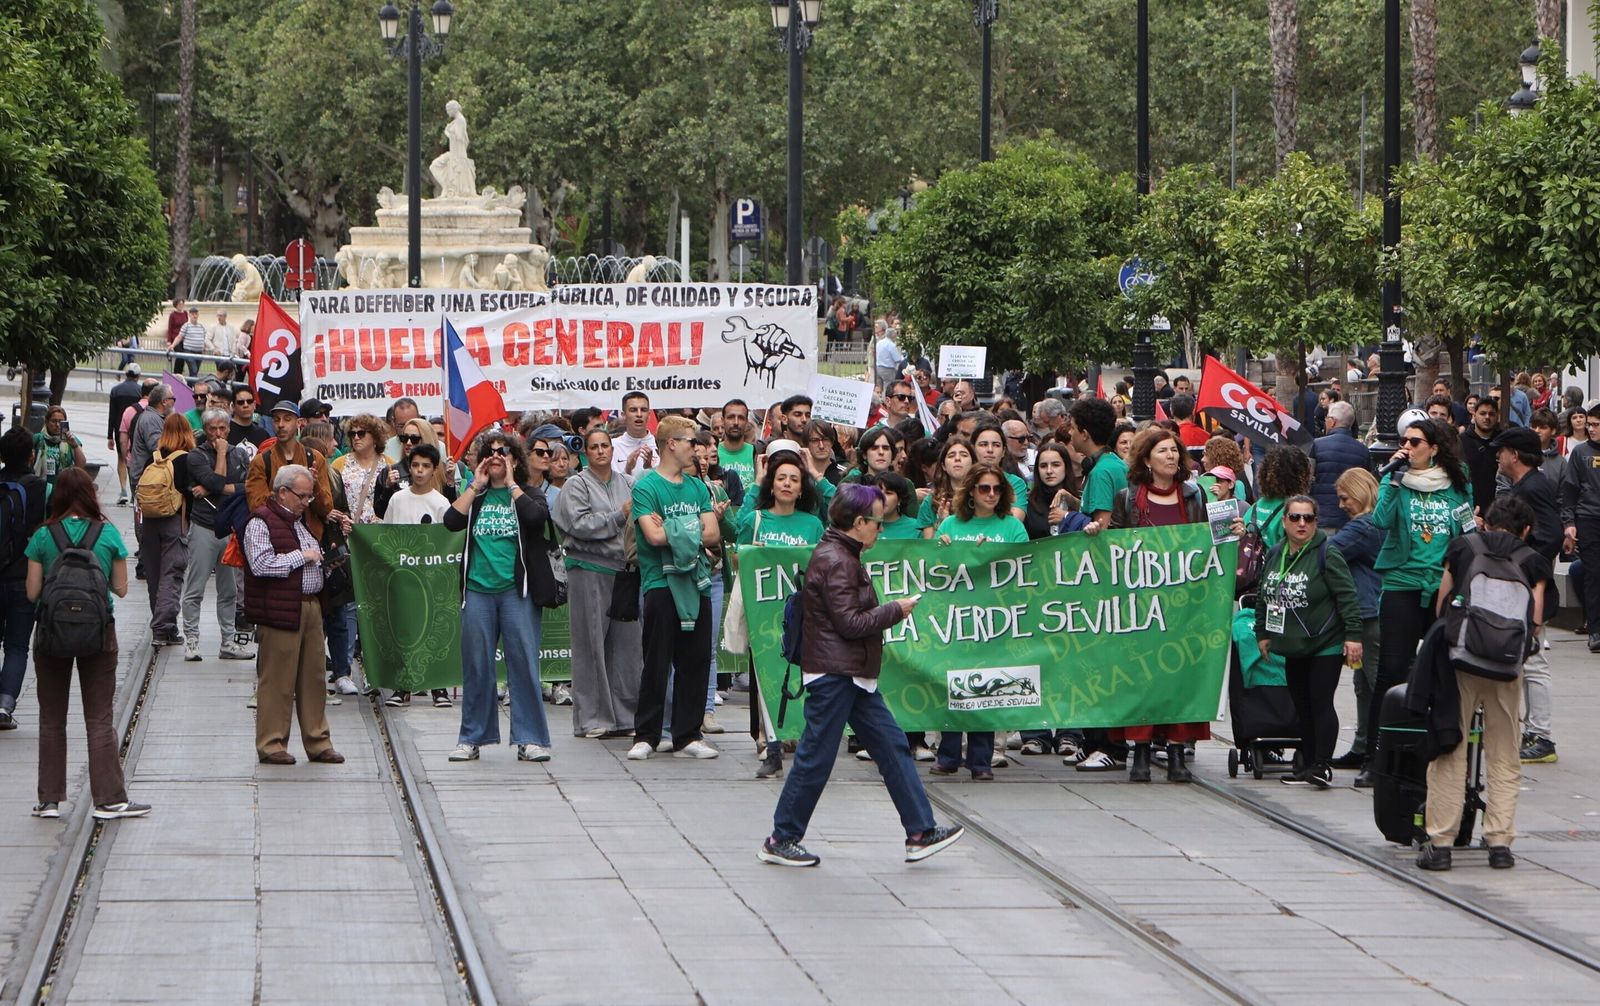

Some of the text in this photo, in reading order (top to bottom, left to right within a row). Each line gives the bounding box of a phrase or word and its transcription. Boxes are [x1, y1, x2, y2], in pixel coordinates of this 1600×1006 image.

[737, 198, 754, 225] P
[308, 295, 350, 314] PARA
[355, 294, 435, 313] DEFENDER
[441, 293, 475, 312] UNA
[480, 293, 546, 313] ESCUELA
[626, 286, 648, 307] DE
[651, 286, 721, 307] CALIDAD
[727, 287, 738, 307] Y
[743, 287, 812, 308] SEGURA
[502, 318, 704, 368] GENERAL!
[316, 383, 385, 400] IZQUIERDA
[530, 375, 721, 392] Sindicato de Estudiantes
[1220, 383, 1301, 440] CGT
[1230, 409, 1279, 443] SEVILLA
[1208, 504, 1234, 514] HUELGA
[399, 553, 420, 567] Por
[425, 554, 442, 566] un
[755, 539, 1225, 602] EN FENSA DE LA PÚBLICA
[928, 603, 1033, 644] VERDE
[1038, 593, 1168, 635] SEVILLA
[949, 697, 1040, 710] MAREA VERDE SEVILLA
